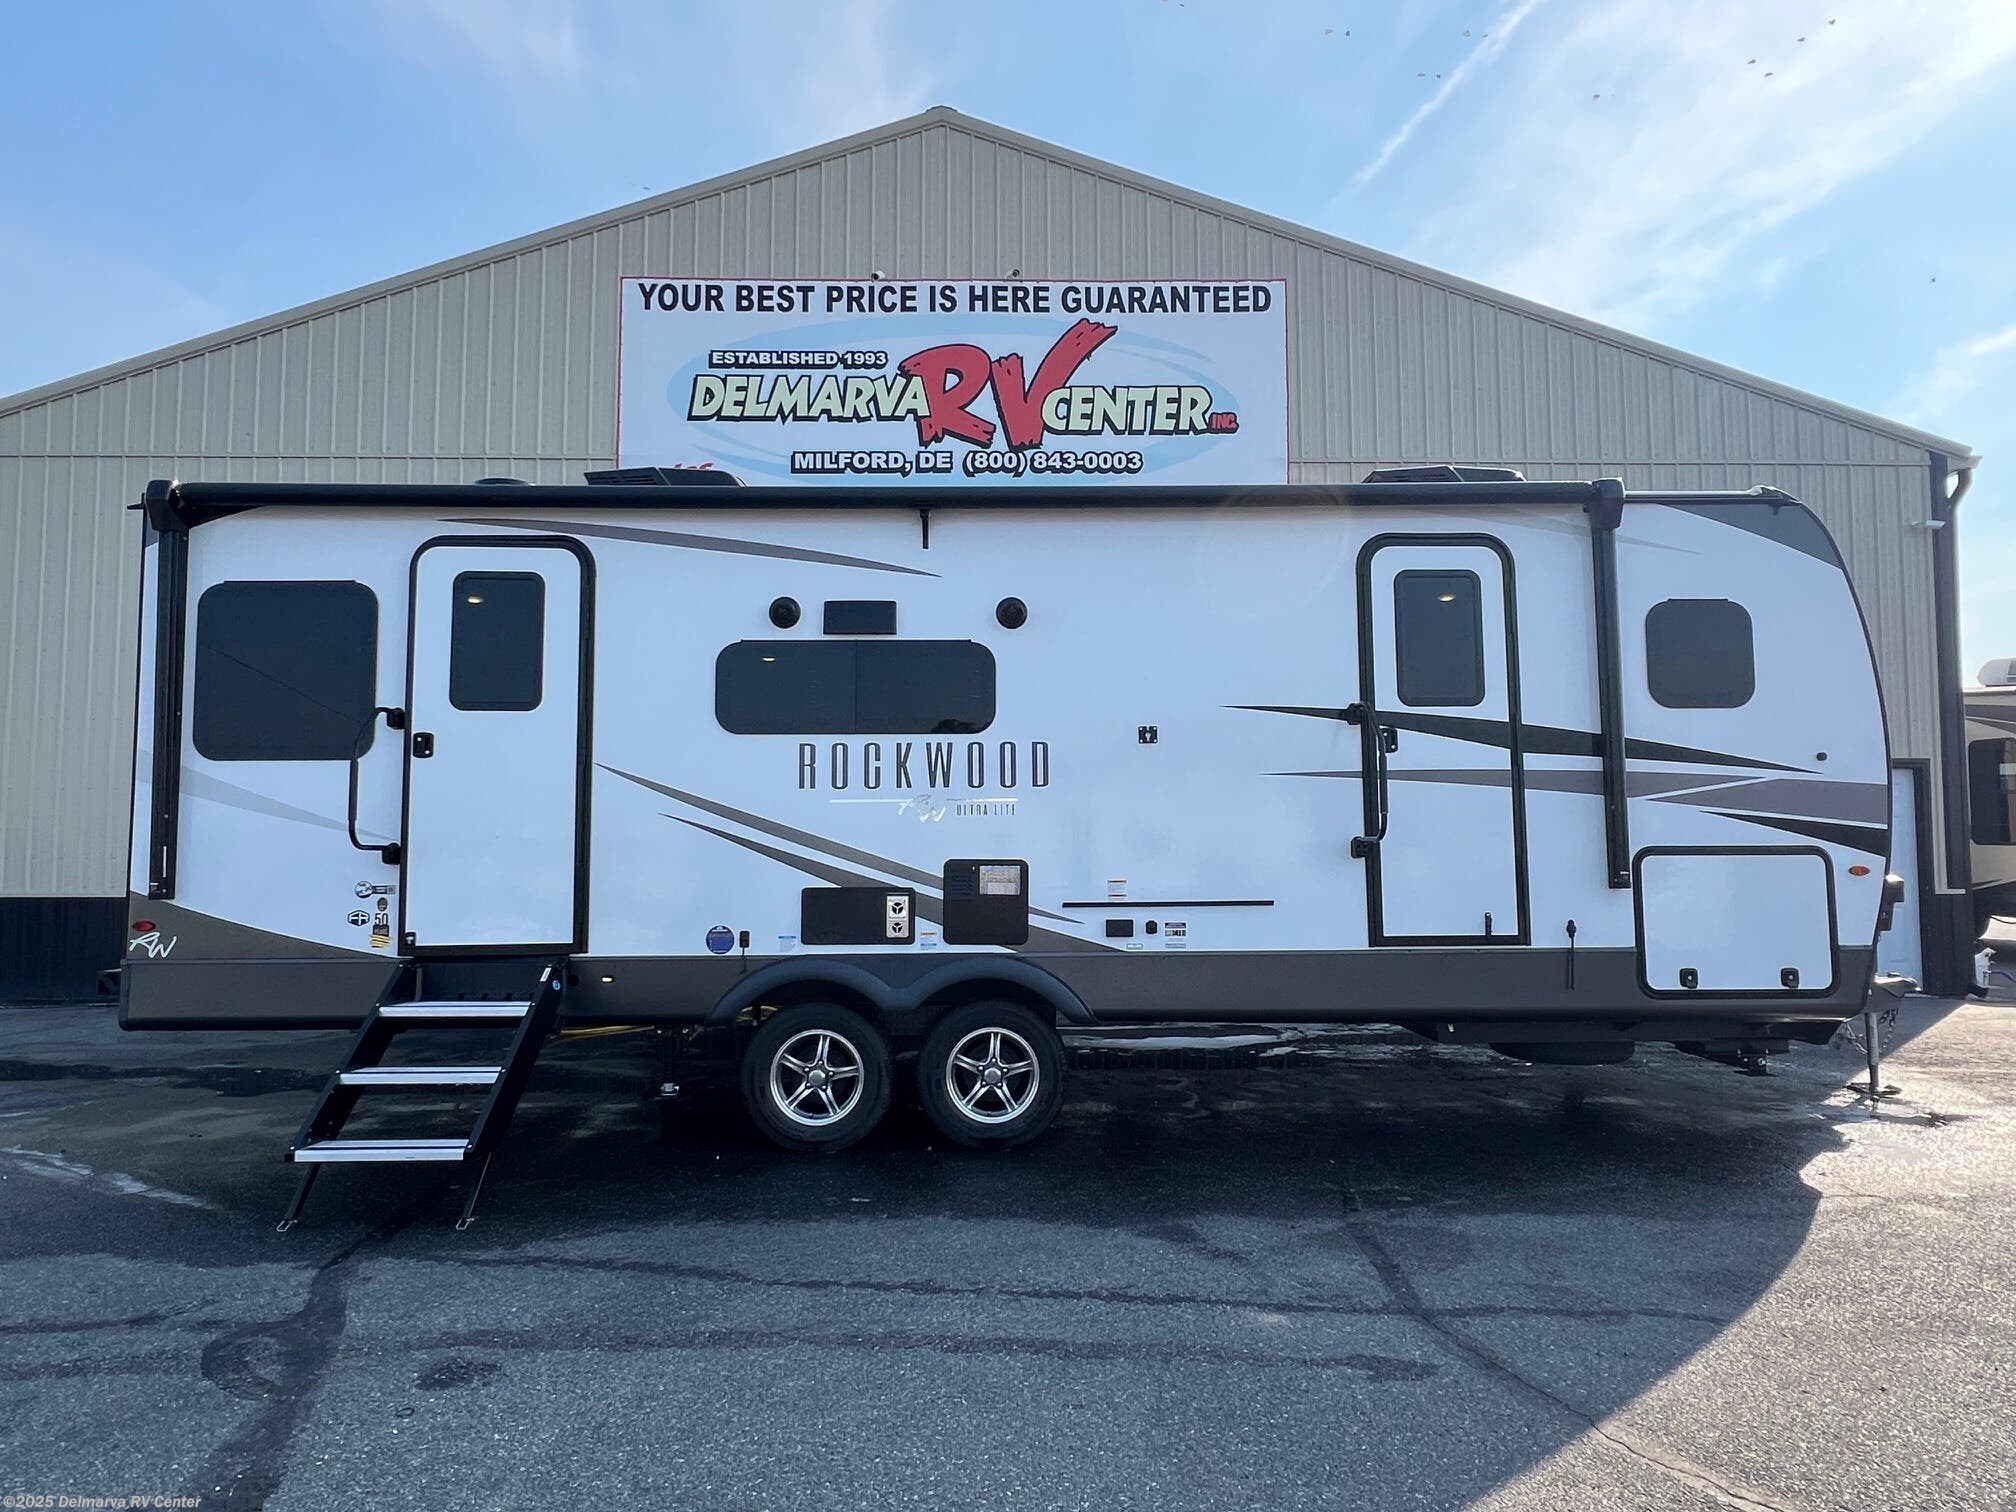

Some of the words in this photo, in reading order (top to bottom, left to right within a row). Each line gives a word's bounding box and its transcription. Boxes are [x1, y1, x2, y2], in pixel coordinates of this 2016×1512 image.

[638, 283, 725, 312] YOUR
[736, 285, 815, 313] BEST
[826, 285, 918, 313] PRICE
[929, 286, 958, 313] IS
[969, 286, 1050, 313] HERE
[1061, 286, 1271, 313] GUARANTEED
[711, 351, 839, 366] ESTABLISHED
[843, 352, 887, 366] 1993
[689, 375, 931, 419] DELMARVA
[898, 318, 1118, 450] RV
[1042, 386, 1213, 434] CENTER
[1210, 412, 1239, 432] INC.
[794, 452, 912, 474] MILFORD,
[919, 452, 951, 469] DE
[966, 452, 1026, 473] (800)
[1034, 452, 1142, 470] 843-0003
[799, 741, 1050, 789] ROCKWOOD
[957, 804, 987, 816] ULTRA
[994, 804, 1016, 816] LITE
